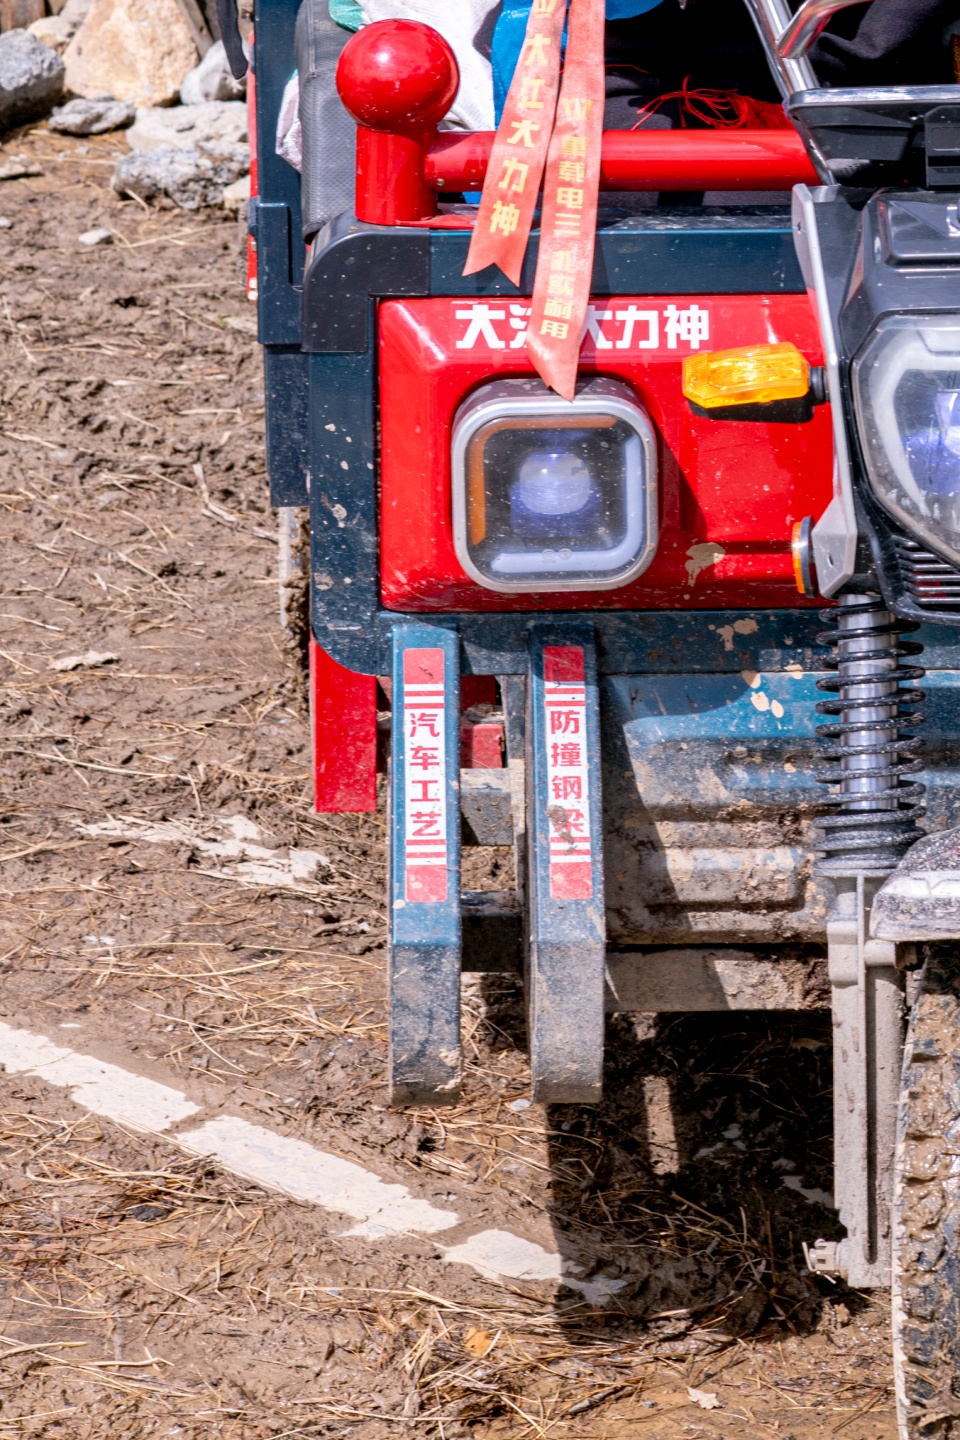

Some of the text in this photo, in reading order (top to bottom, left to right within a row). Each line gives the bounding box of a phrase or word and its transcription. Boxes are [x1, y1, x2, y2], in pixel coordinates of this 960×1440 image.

[489, 33, 550, 237] 大江大力神
[409, 712, 441, 837] 汽车工艺
